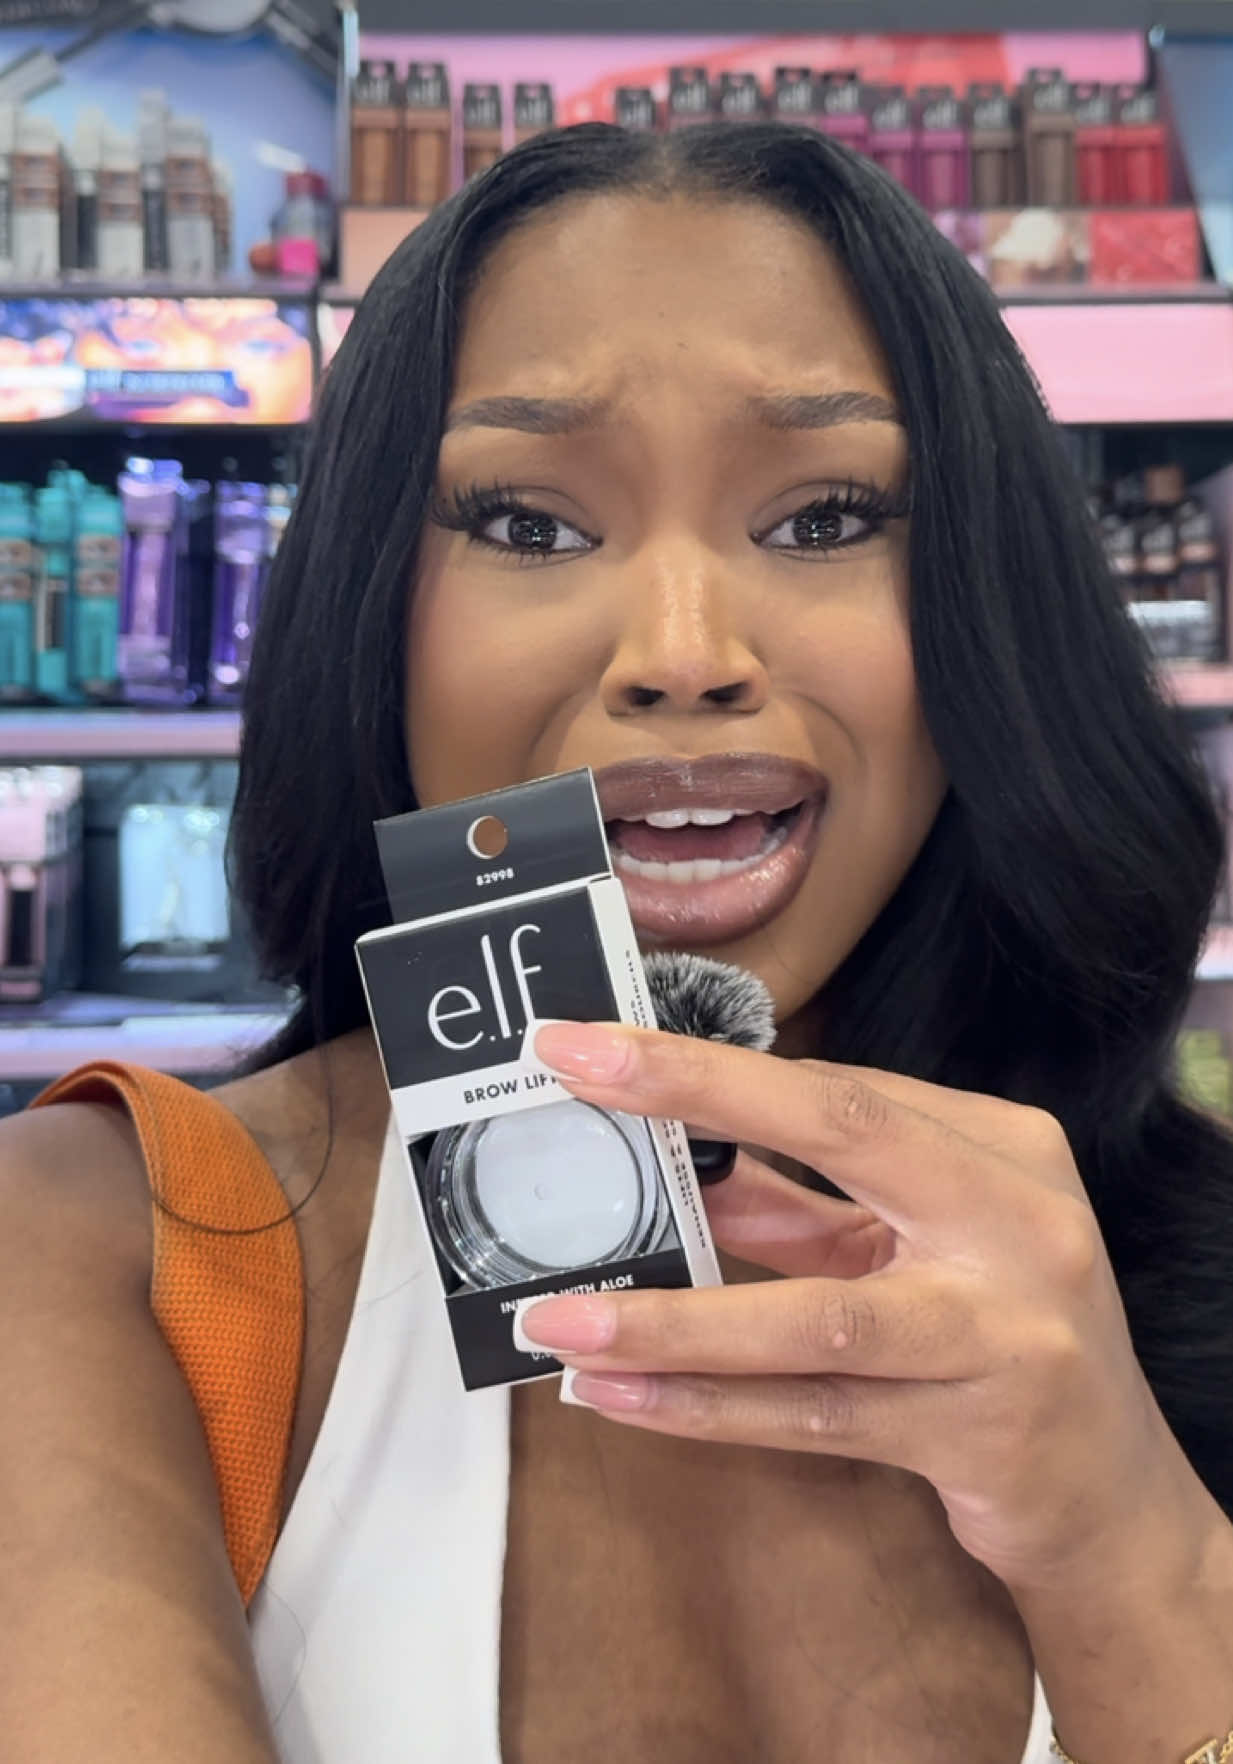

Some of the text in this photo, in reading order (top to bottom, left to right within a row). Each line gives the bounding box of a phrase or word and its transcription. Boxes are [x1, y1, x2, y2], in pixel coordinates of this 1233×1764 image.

[476, 869, 514, 886] 82998
[464, 1079, 518, 1104] BROW
[600, 1274, 634, 1292] ALOE
